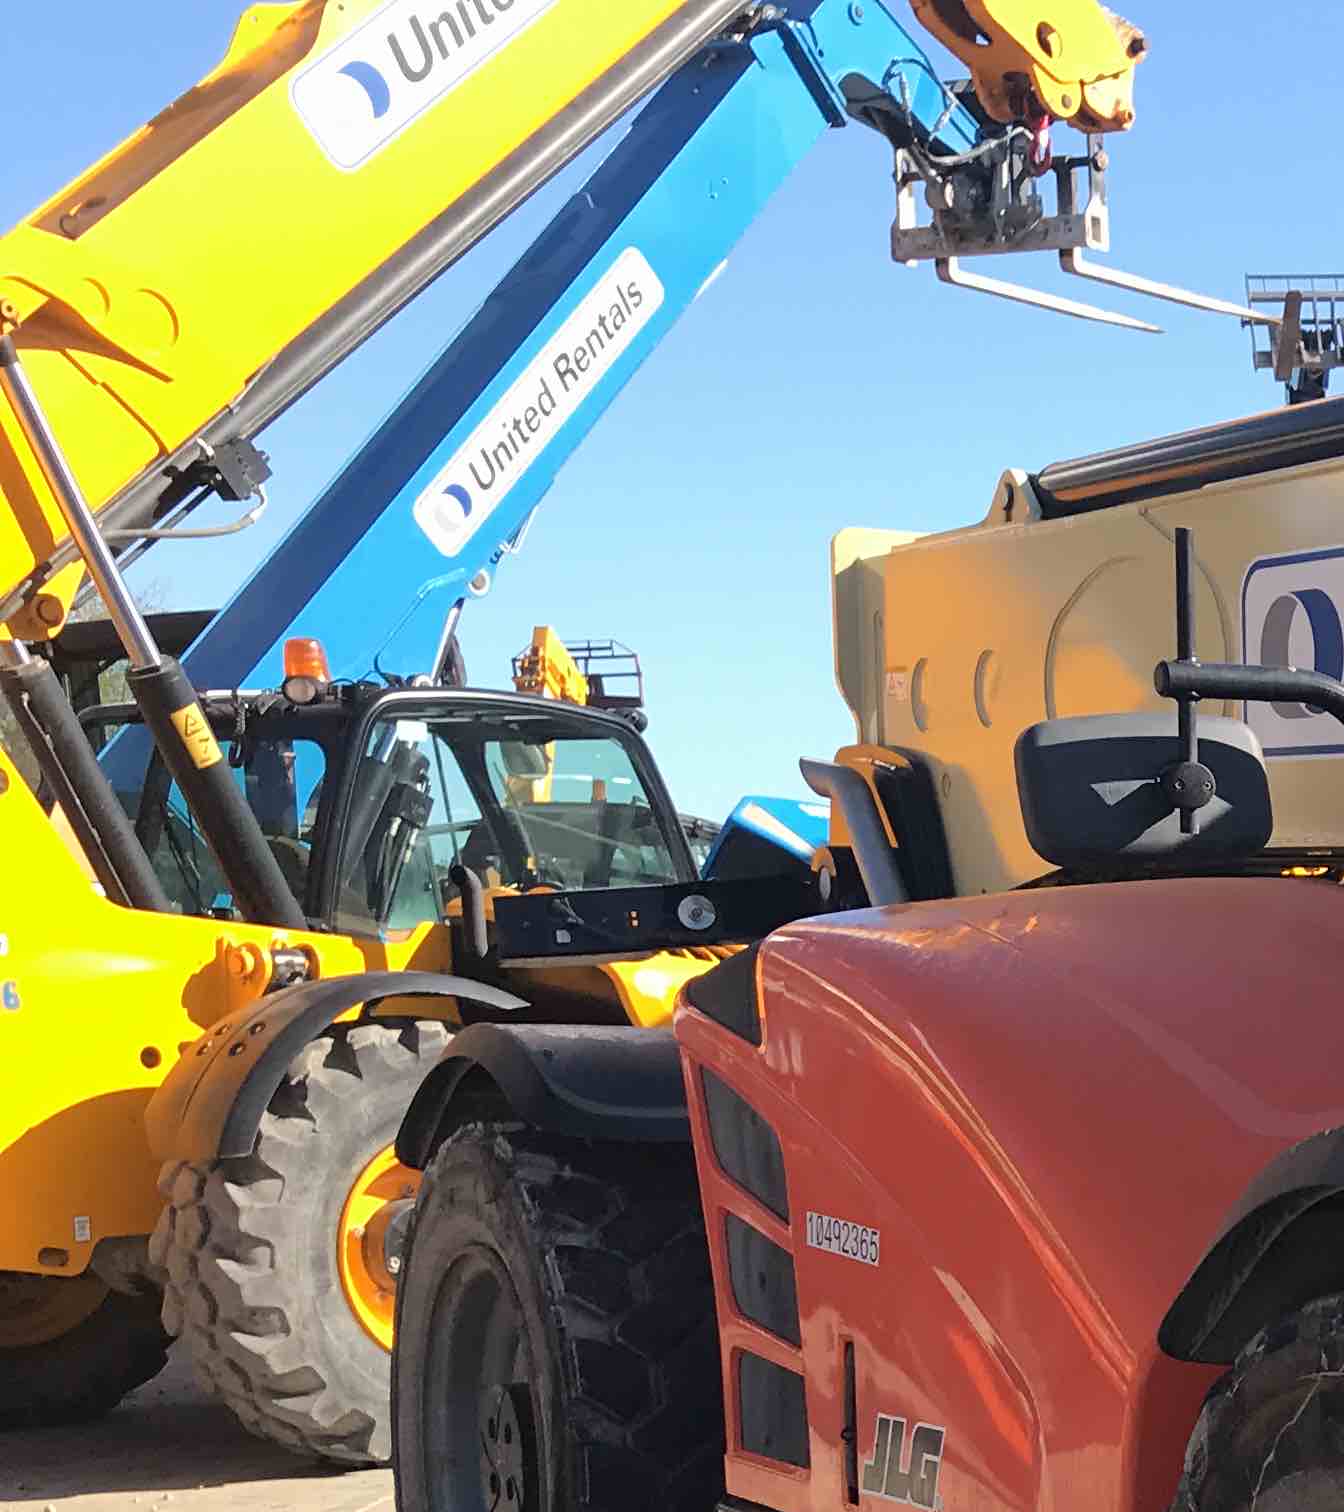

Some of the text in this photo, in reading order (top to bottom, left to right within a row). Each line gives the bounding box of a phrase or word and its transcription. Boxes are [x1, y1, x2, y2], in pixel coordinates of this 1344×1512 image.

[468, 281, 643, 490] United Rentals
[807, 1213, 878, 1263] 10492365
[859, 1412, 945, 1512] JLG
